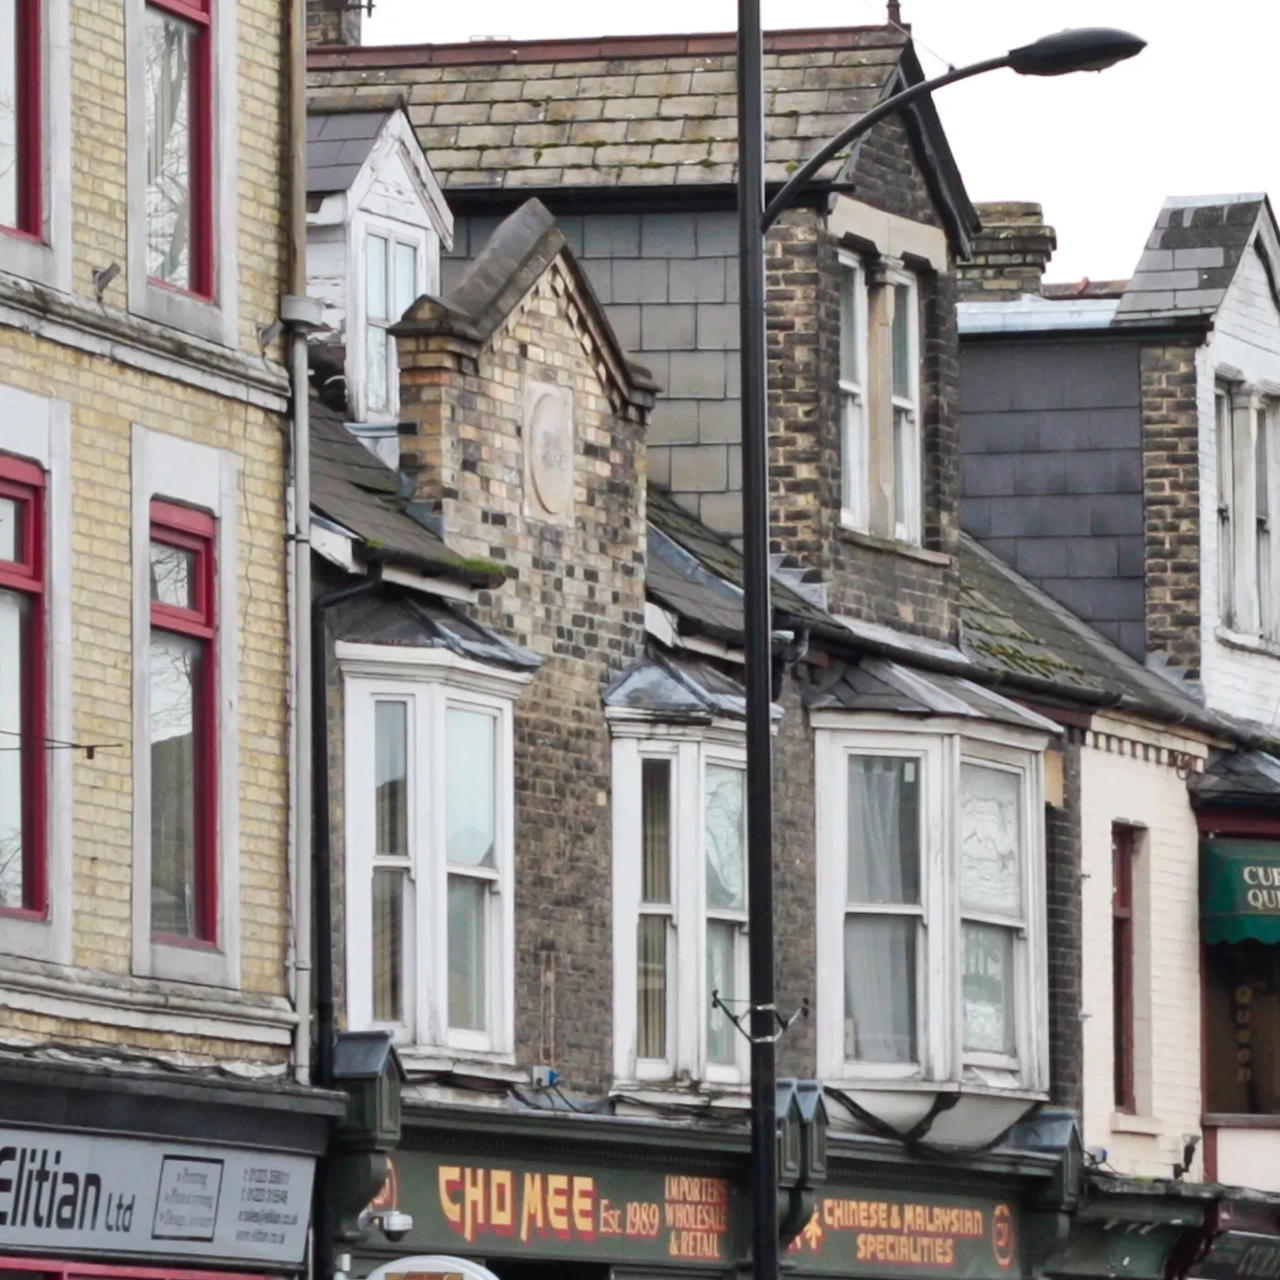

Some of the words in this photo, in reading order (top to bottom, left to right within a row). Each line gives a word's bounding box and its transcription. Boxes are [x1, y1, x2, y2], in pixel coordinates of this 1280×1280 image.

[0, 1146, 101, 1230] Elitian
[105, 1192, 136, 1233] Ltd
[664, 1174, 728, 1203] IMPORTERS
[520, 1172, 597, 1242] MEE
[626, 1201, 660, 1237] 1989
[664, 1202, 728, 1231] WHOLESALE
[823, 1198, 888, 1229] CHINESE
[889, 1207, 901, 1231] &
[903, 1204, 984, 1236] MALAYSIAN
[669, 1230, 680, 1256] &
[681, 1230, 721, 1258] RETAIL
[857, 1233, 954, 1264] SPECIALITIES
